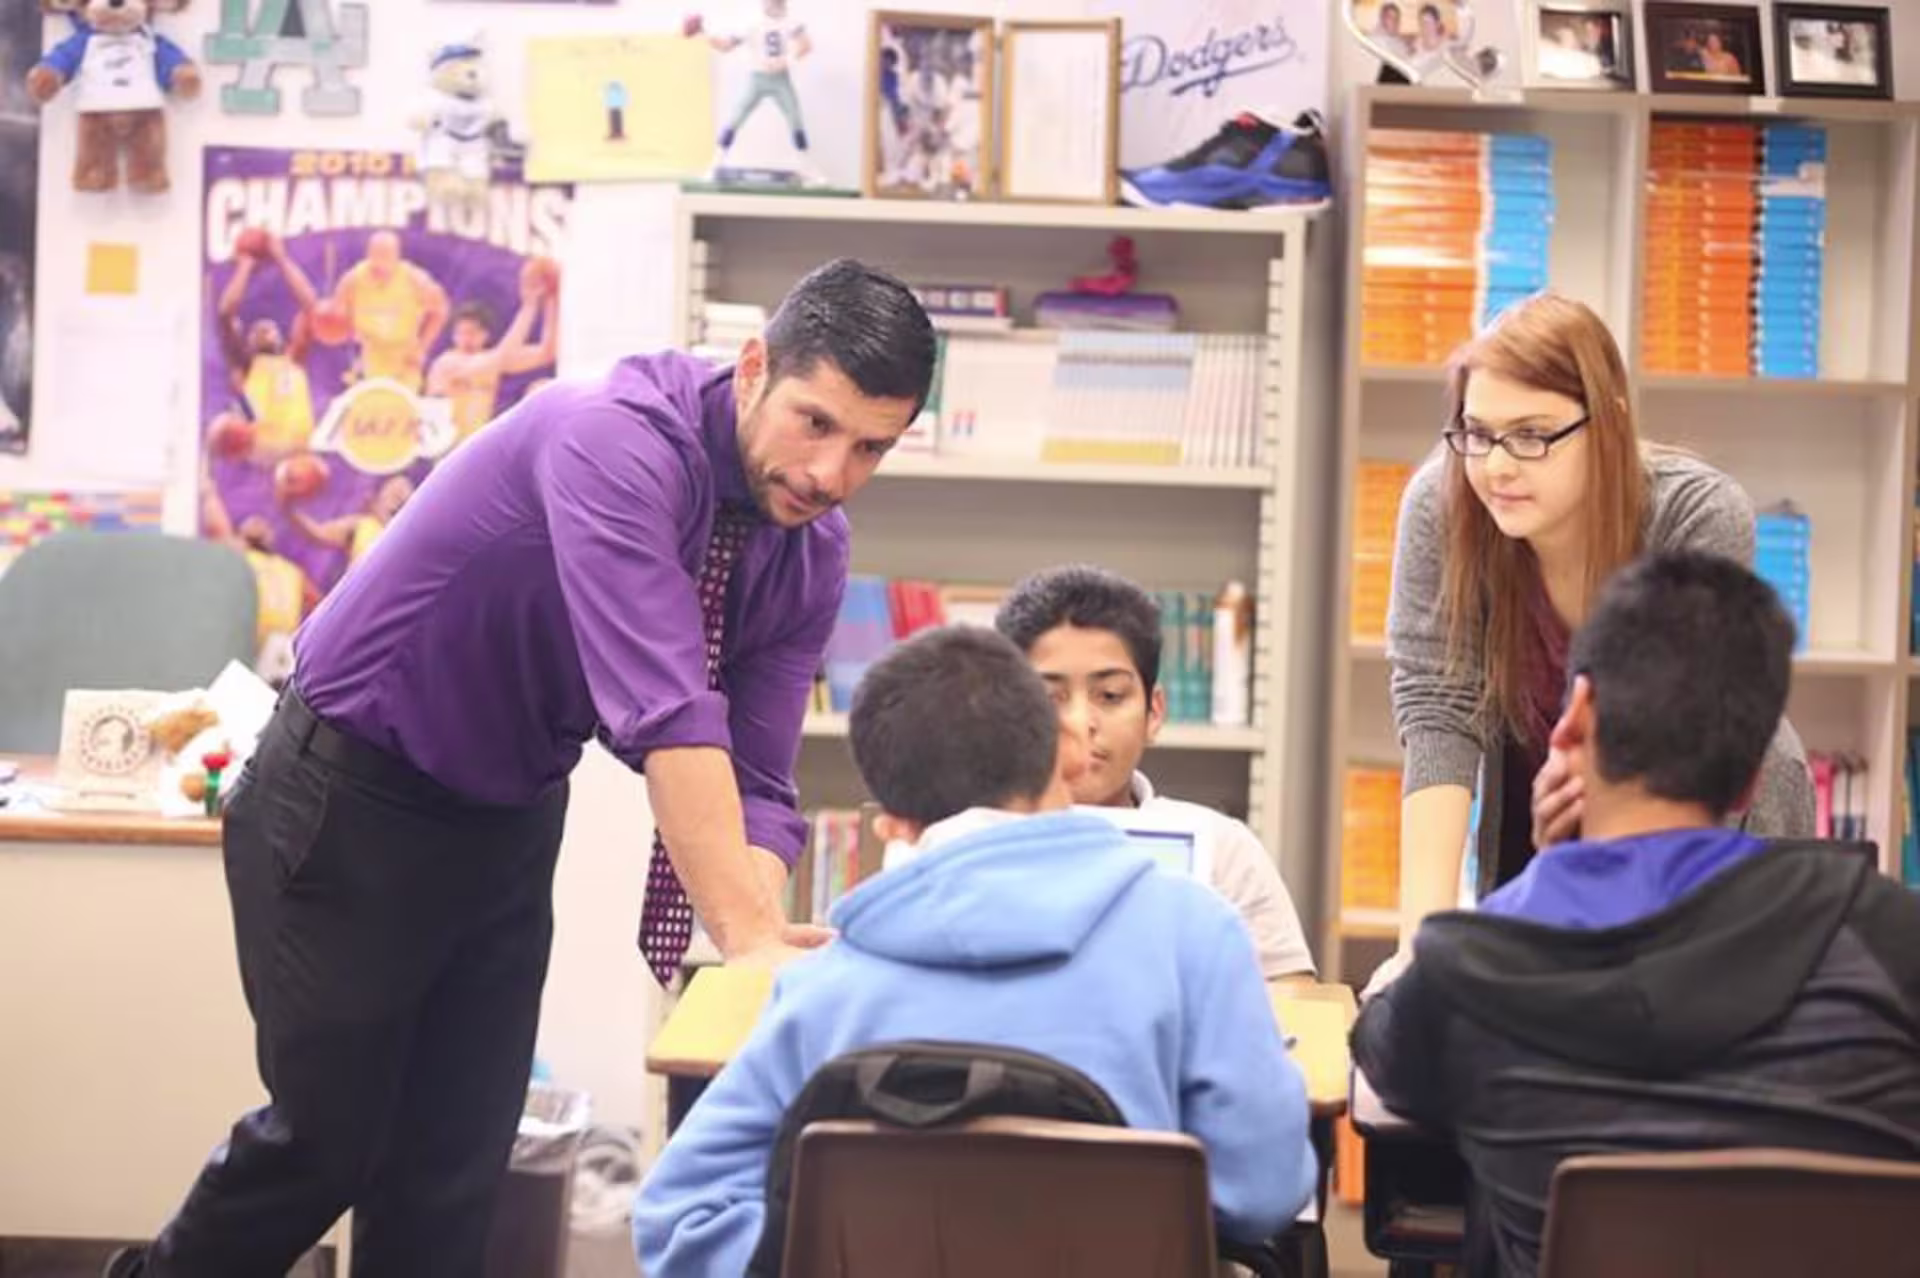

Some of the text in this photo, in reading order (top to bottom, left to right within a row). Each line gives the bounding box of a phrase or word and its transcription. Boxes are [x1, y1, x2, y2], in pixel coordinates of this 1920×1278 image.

[1119, 15, 1298, 98] Dodgers
[290, 152, 390, 176] 2010
[207, 175, 570, 263] CHAMPIONS
